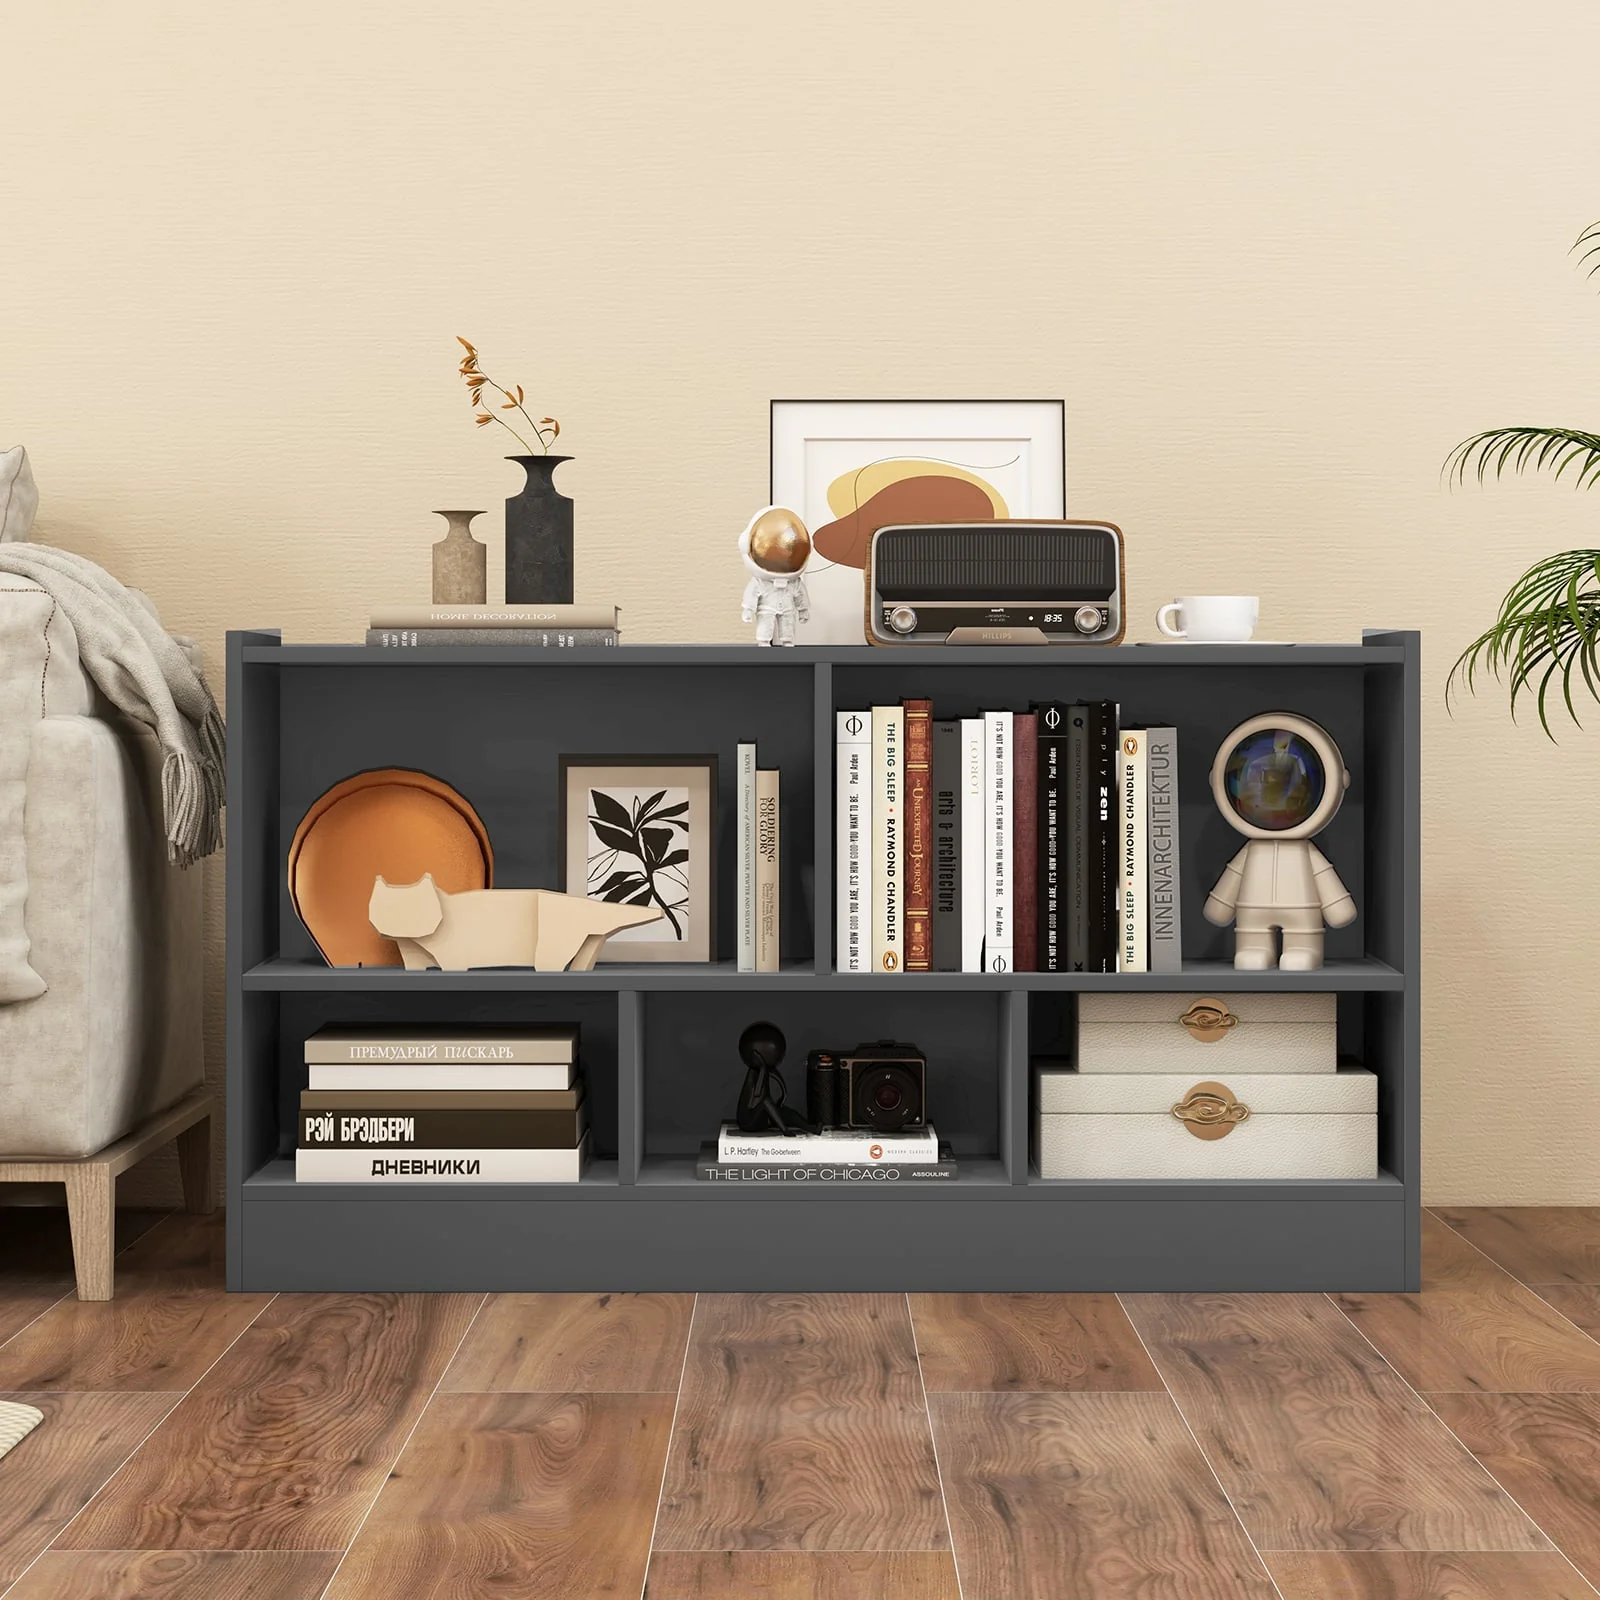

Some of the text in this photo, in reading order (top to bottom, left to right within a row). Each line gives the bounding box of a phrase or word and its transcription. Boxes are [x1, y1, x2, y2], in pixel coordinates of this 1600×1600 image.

[1043, 614, 1063, 622] 18:35
[982, 632, 1012, 640] HILLIPS
[1048, 747, 1057, 778] Paul Arden
[1100, 703, 1108, 820] simply zen
[850, 754, 858, 784] Paul Arden
[849, 794, 858, 802] BE.
[1048, 788, 1057, 798] BE.
[938, 791, 956, 815] arts
[849, 814, 858, 829] WANT
[912, 788, 924, 852] UNEXPECTED
[1048, 809, 1057, 825] WANT
[887, 722, 896, 942] THE BIG SLEEP RAYMOND CHANDLER
[1151, 744, 1174, 940] INNENARCHITEKTUR
[849, 861, 858, 873] HOW
[1048, 858, 1057, 870] HOW
[1126, 764, 1134, 964] THE BIG SLEEP RAYMOND CHANDLER
[849, 875, 858, 885] IT'S
[910, 852, 924, 896] JOURNEY
[938, 836, 956, 912] architecture
[1048, 872, 1057, 883] IT'S
[849, 888, 858, 900] ARE,
[1048, 885, 1057, 898] ARE,
[849, 902, 858, 913] YOU
[1048, 900, 1057, 911] YOU
[849, 916, 858, 930] GOOD
[1048, 914, 1057, 928] GOOD
[849, 932, 858, 944] HOW
[1048, 931, 1057, 944] HOW
[849, 946, 858, 957] NOT
[1048, 946, 1057, 956] NOT
[849, 959, 858, 970] IT'S
[1048, 959, 1057, 970] IT'S
[350, 1044, 438, 1058] ПРЕМУДРЫЙ
[306, 1112, 414, 1142] РЭЙ БРЭДБЕРИ
[737, 1147, 758, 1157] Hartley
[372, 1160, 480, 1176] ДНЕВНИКИ
[705, 1168, 900, 1180] THE LIGHT OF CHICAGO
